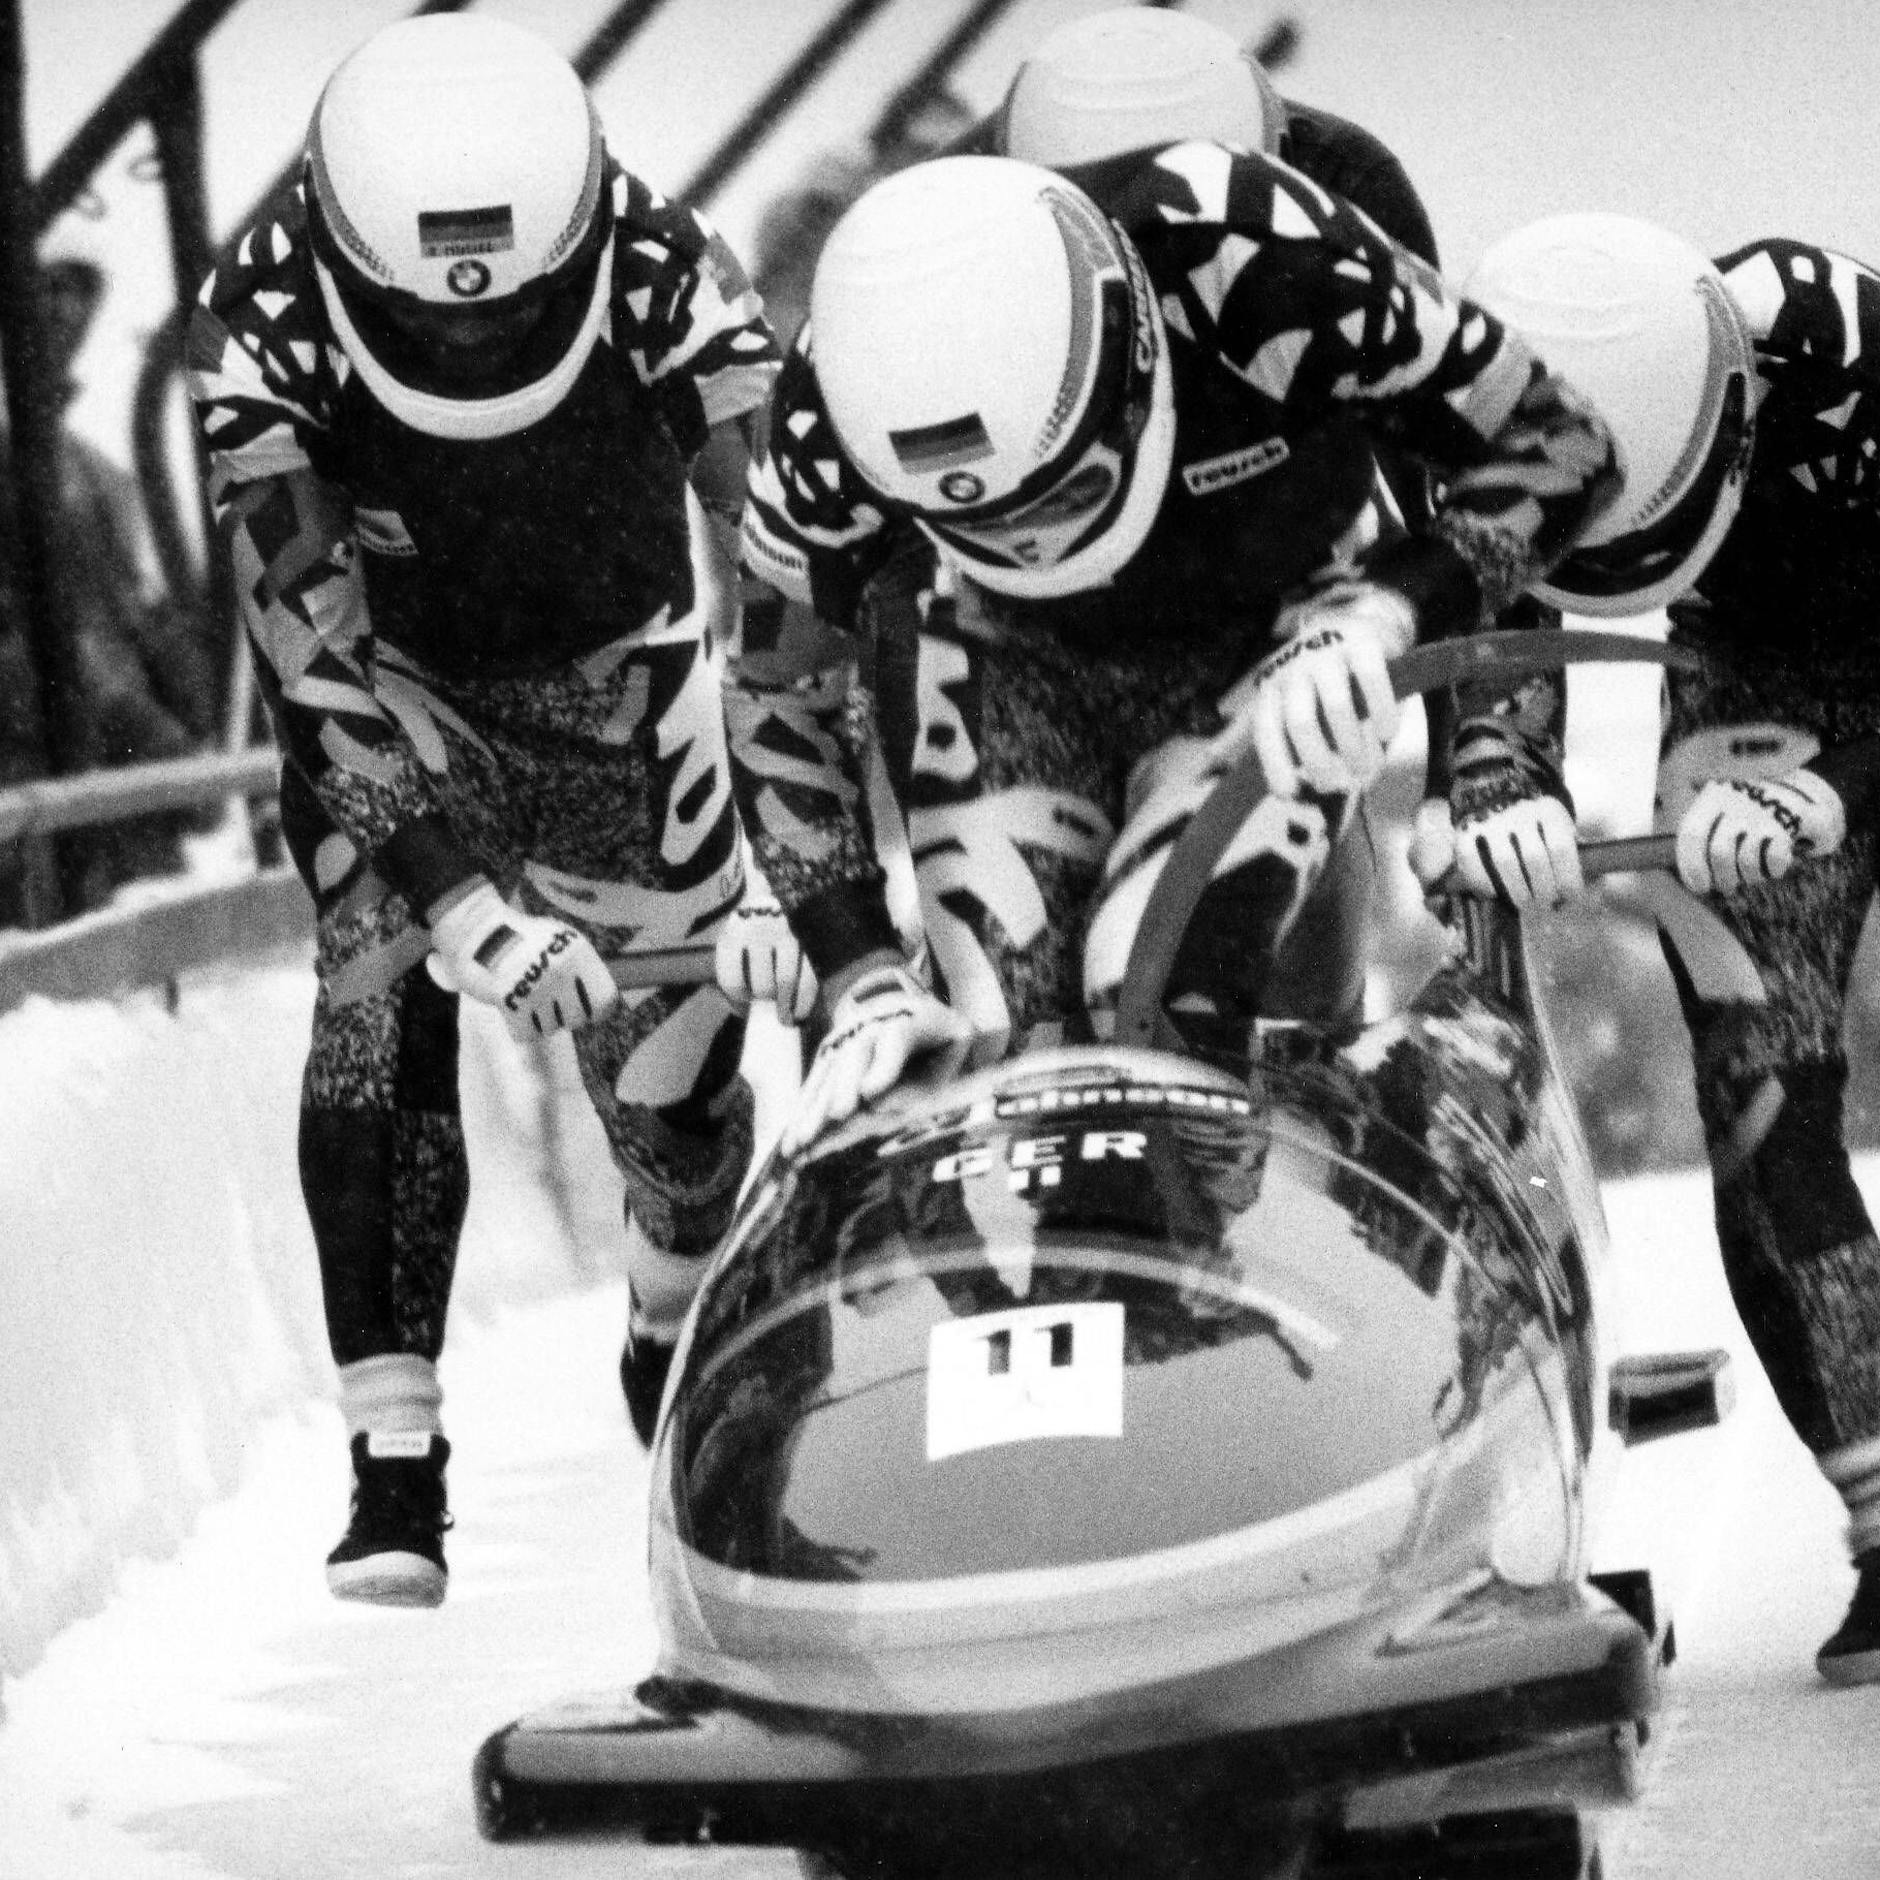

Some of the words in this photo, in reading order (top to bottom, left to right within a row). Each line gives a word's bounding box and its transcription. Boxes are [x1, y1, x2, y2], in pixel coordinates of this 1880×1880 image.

[1190, 445, 1284, 488] reusch
[504, 930, 578, 1012] reusch
[932, 1130, 1148, 1183] GER
[975, 1320, 1074, 1376] 11
